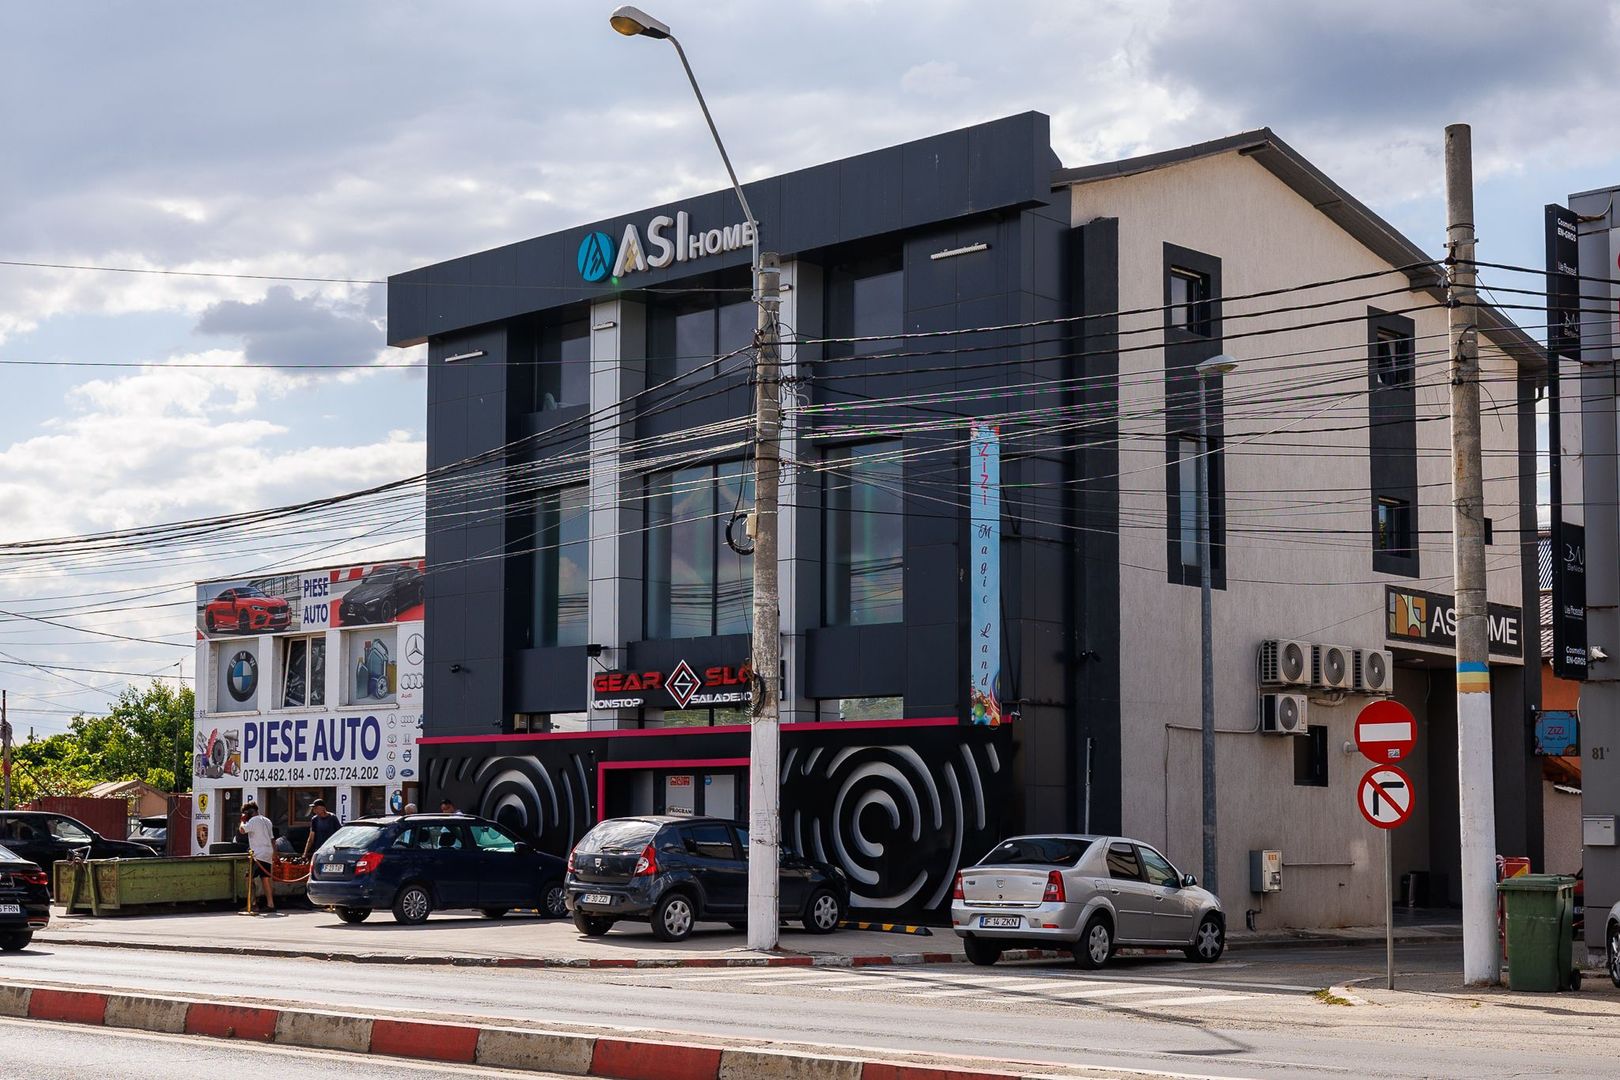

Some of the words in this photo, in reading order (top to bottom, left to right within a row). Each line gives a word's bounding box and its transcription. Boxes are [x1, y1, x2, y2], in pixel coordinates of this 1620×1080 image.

[612, 210, 688, 277] ASI
[689, 220, 759, 259] HOME
[978, 524, 992, 604] Magic
[303, 577, 329, 598] PIESE
[303, 603, 328, 624] AUTO
[1431, 606, 1457, 636] AS
[1486, 614, 1518, 645] ME
[980, 622, 991, 686] Land
[593, 671, 664, 693] GEAR
[704, 665, 753, 687] SLO
[590, 698, 643, 709] NONSTOP
[243, 719, 309, 763] PIESE
[312, 715, 381, 761] AUTO
[243, 767, 304, 782] 0734.482.184
[313, 766, 379, 780] 0723.724.202
[3, 904, 19, 912] FRN
[993, 918, 999, 926] 14
[1001, 917, 1017, 926] ZKN
